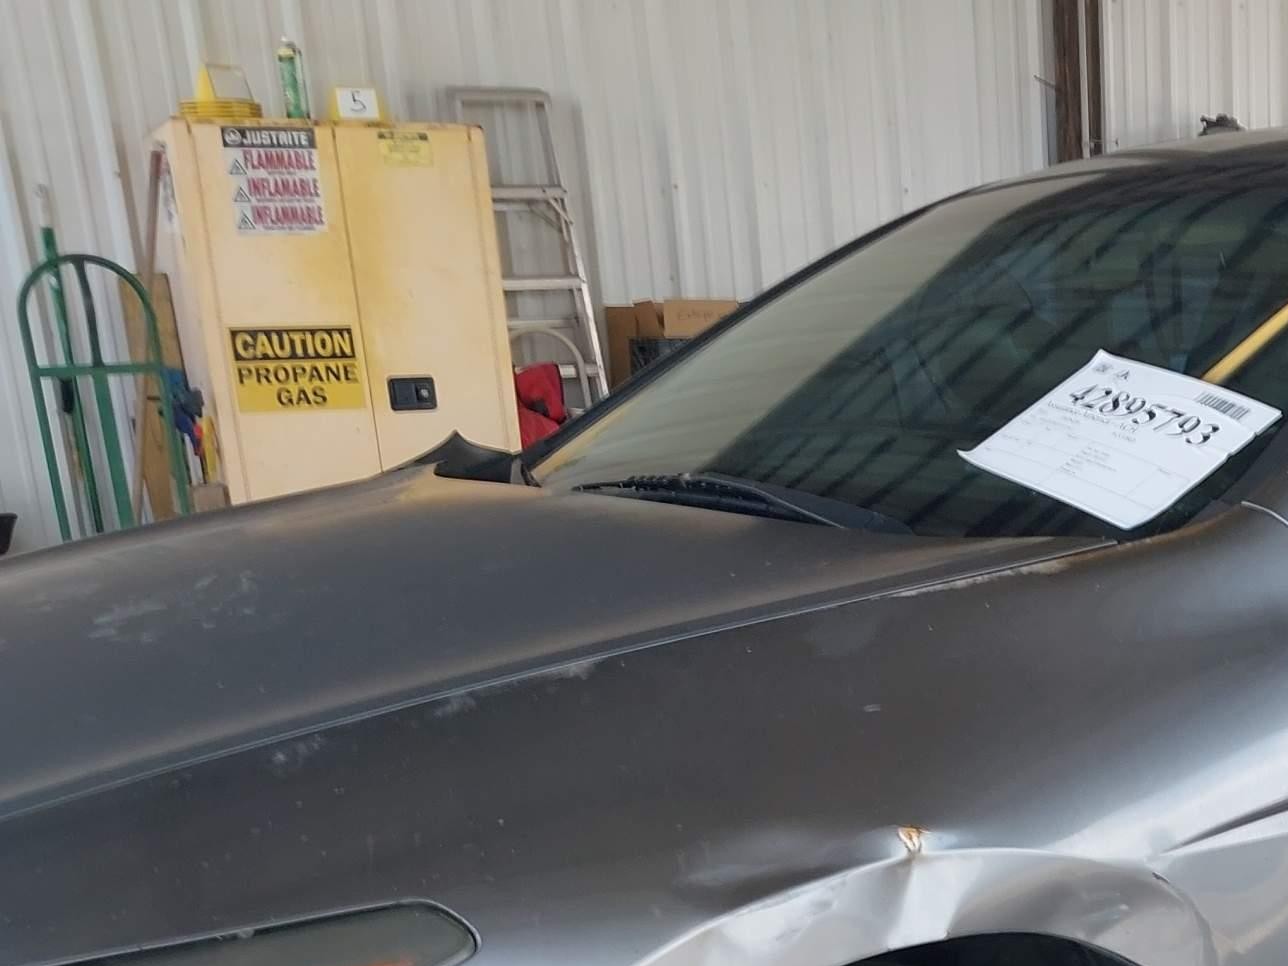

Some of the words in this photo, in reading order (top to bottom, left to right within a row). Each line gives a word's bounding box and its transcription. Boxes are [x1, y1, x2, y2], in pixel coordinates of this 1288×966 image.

[350, 89, 368, 113] 5
[240, 129, 310, 146] JUSTRITE
[242, 149, 317, 171] FLAMMABLE
[246, 176, 320, 198] INFLAMABLE
[251, 204, 325, 225] INFLAMMABLE
[235, 330, 353, 359] CAUTION
[237, 363, 359, 385] PROPANE
[276, 386, 328, 407] GAS
[1069, 383, 1220, 445] 42895793
